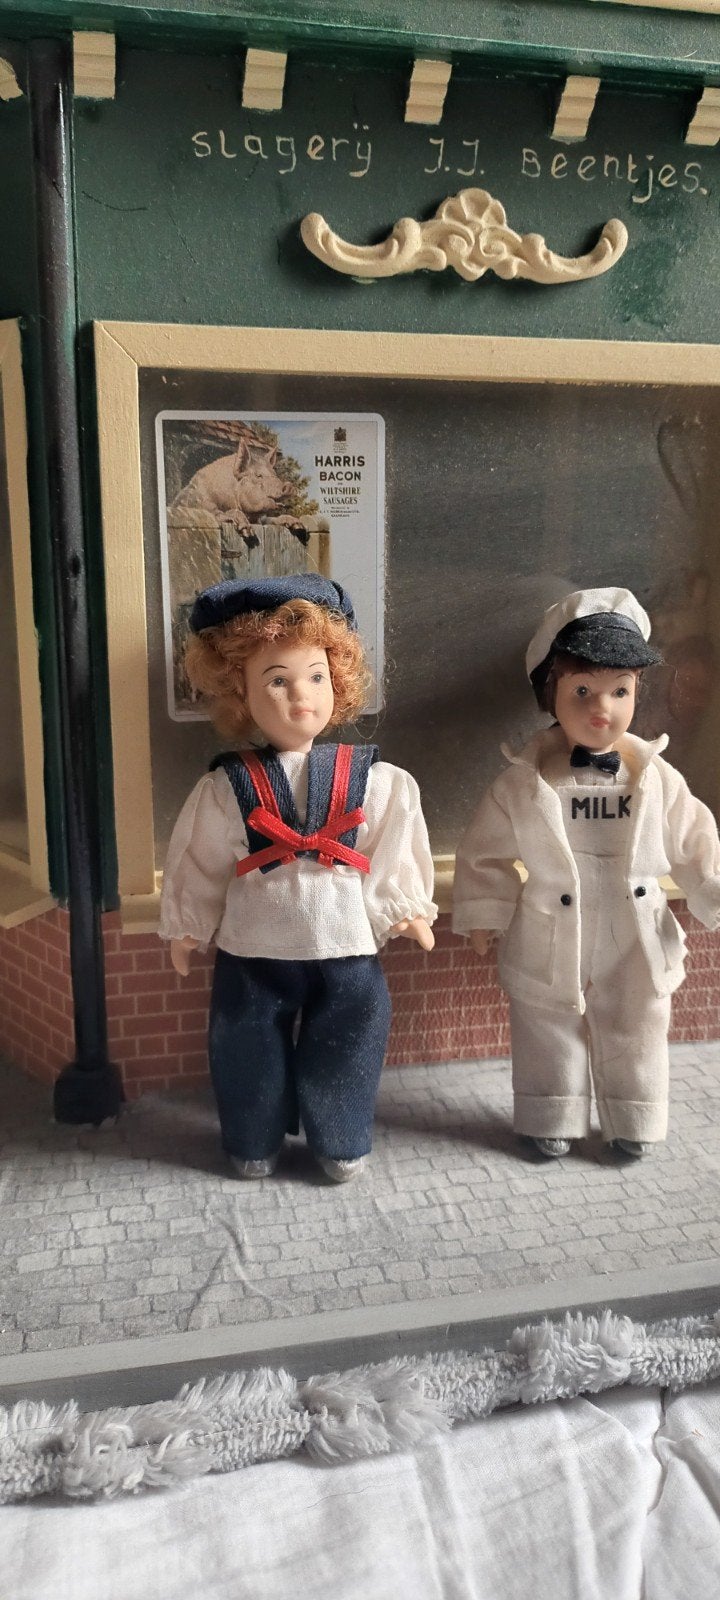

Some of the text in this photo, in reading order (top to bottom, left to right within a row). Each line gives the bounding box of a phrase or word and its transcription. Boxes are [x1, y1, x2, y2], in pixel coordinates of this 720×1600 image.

[314, 455, 365, 467] HARRIS
[319, 471, 362, 481] BACON
[320, 486, 361, 495] WILTSHIRE
[323, 497, 358, 505] SAUSAGES
[571, 795, 632, 819] MILK
